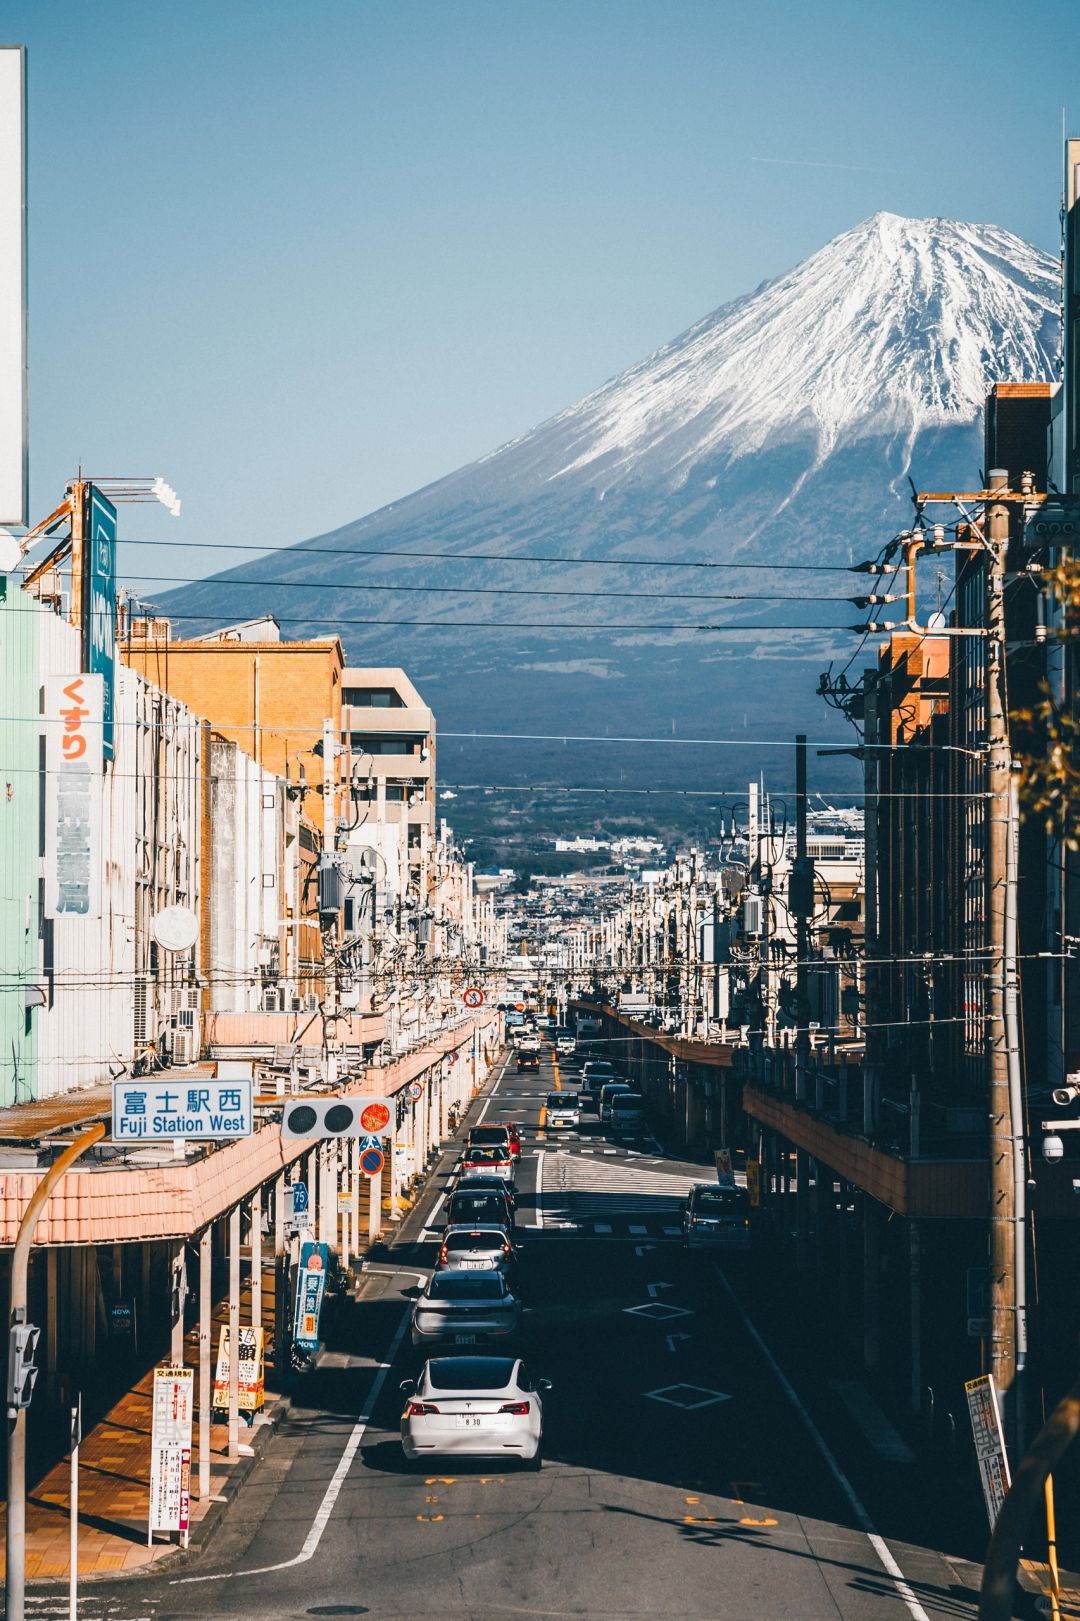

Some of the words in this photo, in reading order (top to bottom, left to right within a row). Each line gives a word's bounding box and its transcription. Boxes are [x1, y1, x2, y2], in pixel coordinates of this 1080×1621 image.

[60, 678, 89, 760] くすり
[123, 1088, 242, 1115] 富士駅西
[120, 1117, 147, 1137] Fuji
[153, 1114, 203, 1133] Station
[209, 1113, 245, 1131] West
